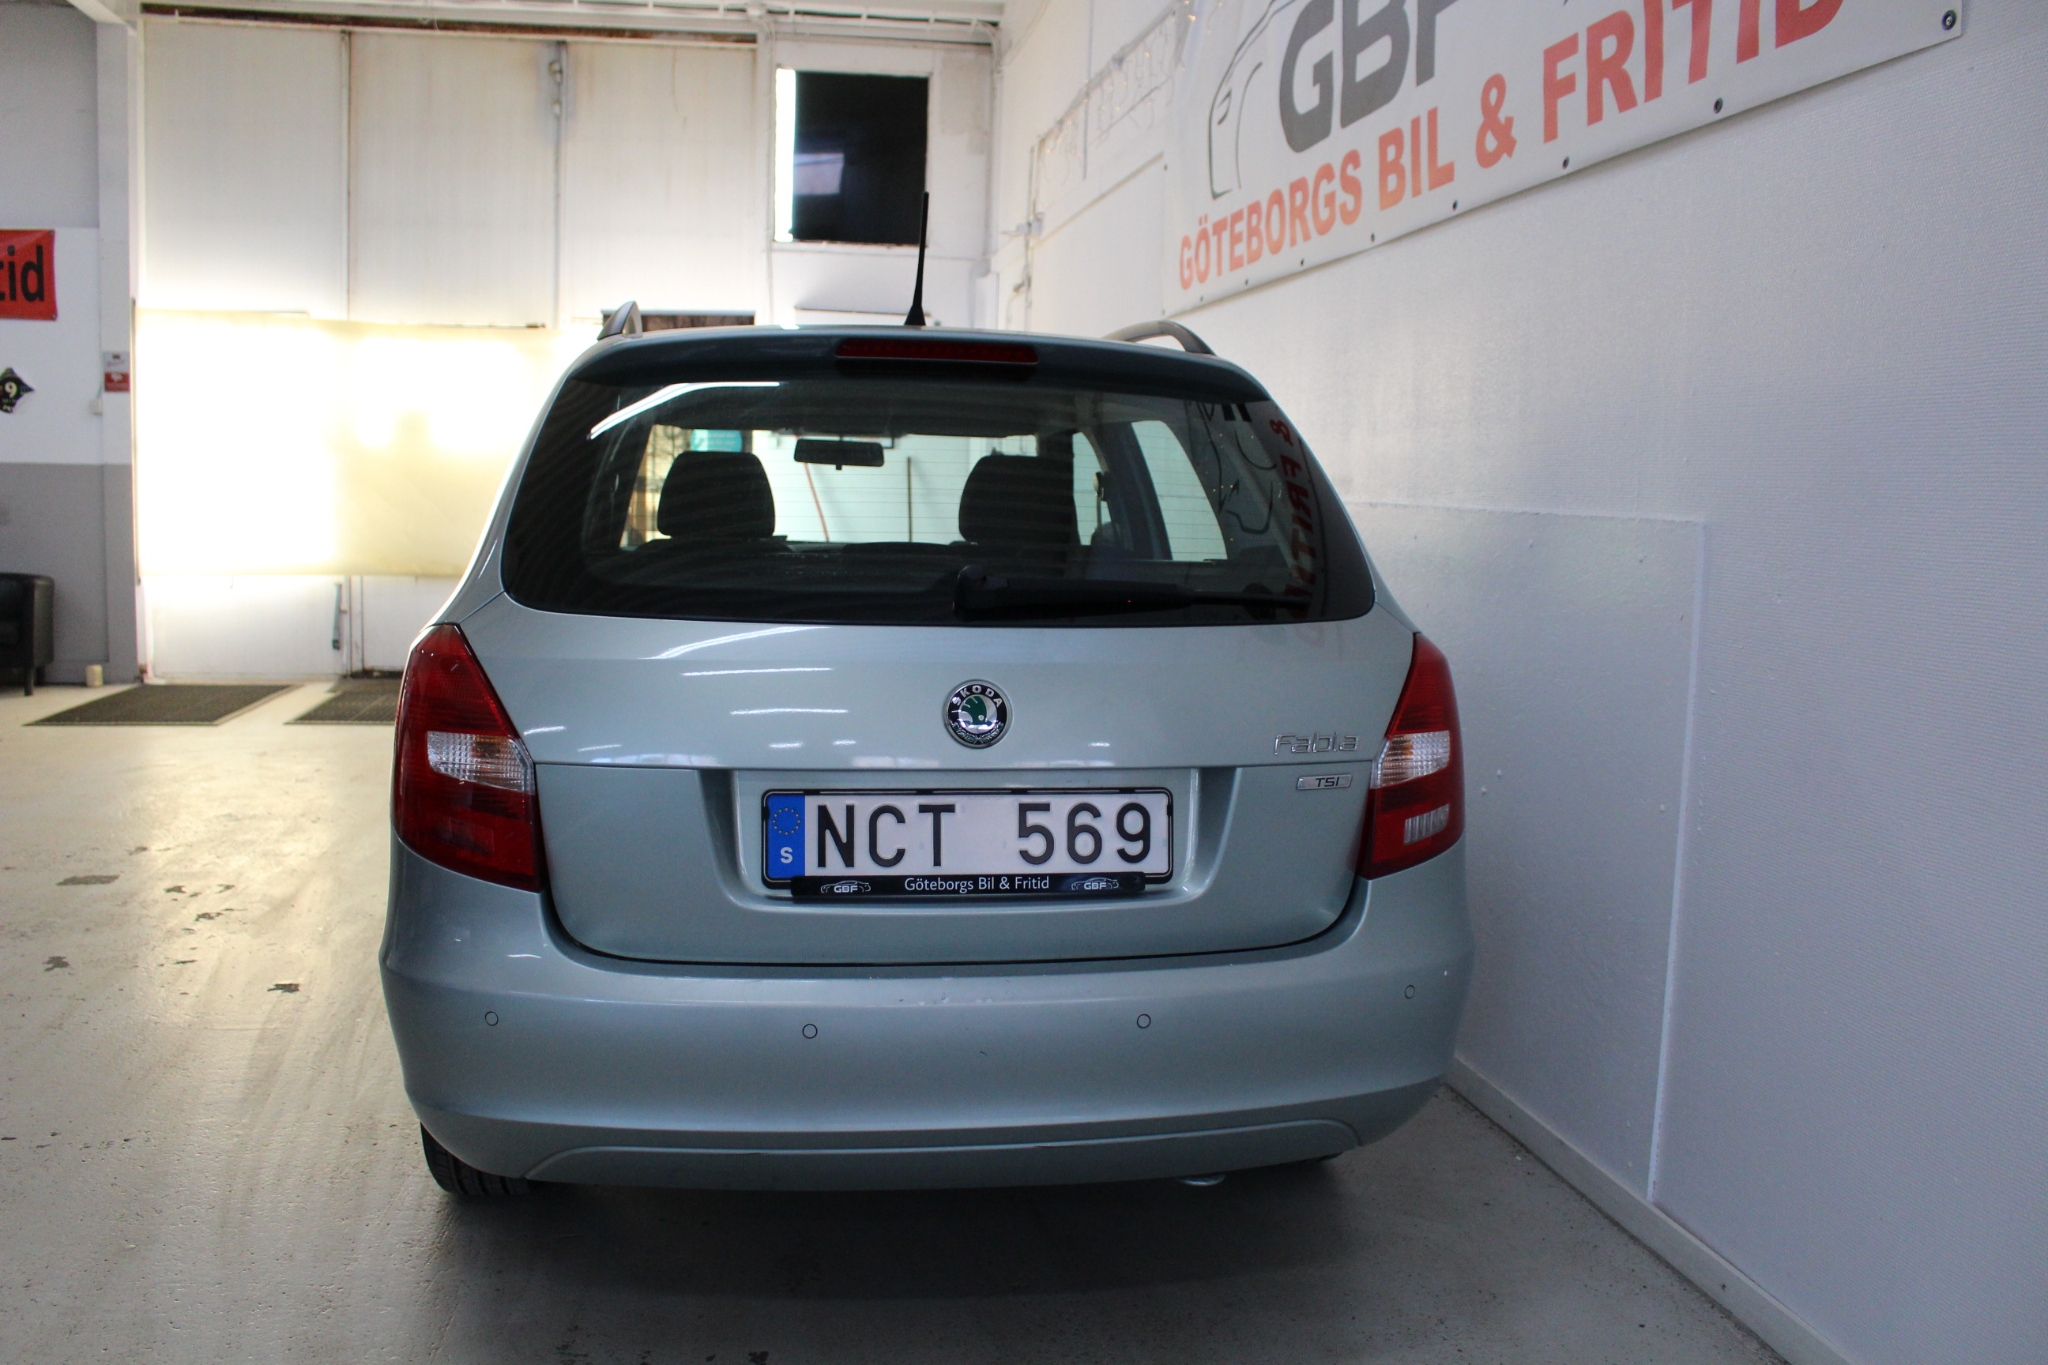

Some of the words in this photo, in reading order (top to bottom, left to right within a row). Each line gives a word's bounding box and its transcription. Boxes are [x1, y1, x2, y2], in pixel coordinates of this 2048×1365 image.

[1179, 149, 1363, 290] GÖTEBORGS
[1378, 106, 1455, 212] BIL
[1475, 73, 1518, 169] &
[0, 245, 45, 302] id
[1274, 731, 1359, 755] Fabia
[1315, 776, 1340, 788] TSI
[816, 803, 956, 868] NCT
[1018, 801, 1151, 866] 569
[779, 846, 793, 864] S
[833, 885, 858, 893] GBF
[904, 877, 974, 894] Göteborgs
[978, 876, 995, 890] Bil
[999, 876, 1010, 890] &
[1015, 875, 1050, 890] Fritid
[1083, 882, 1107, 890] GBF
